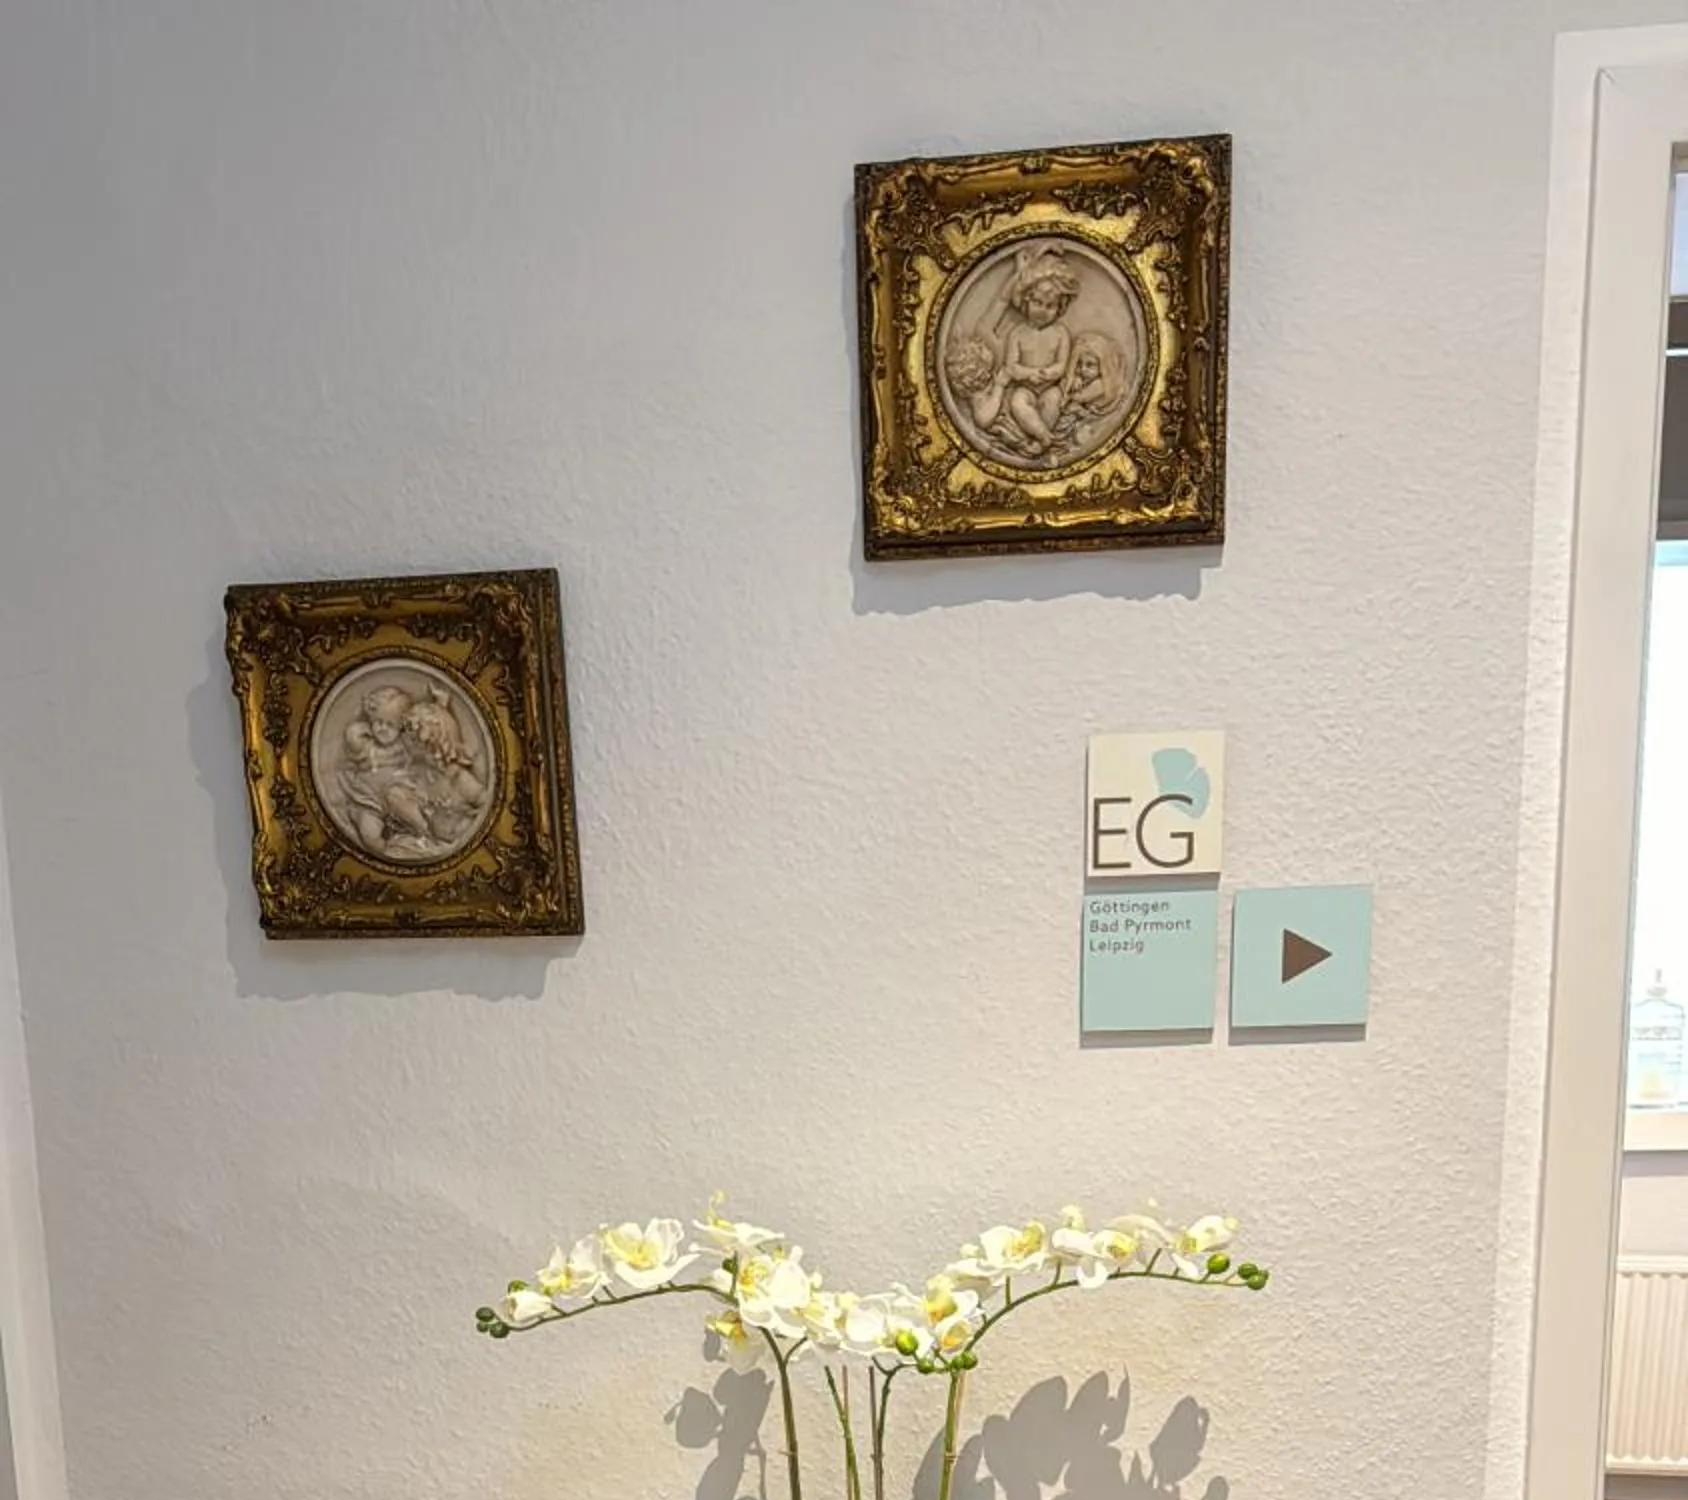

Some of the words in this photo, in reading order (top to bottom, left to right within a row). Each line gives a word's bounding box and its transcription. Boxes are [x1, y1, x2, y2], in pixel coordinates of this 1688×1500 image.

[1092, 793, 1195, 870] EG
[1089, 899, 1170, 916] Göttingen
[1089, 919, 1119, 933] Bad
[1125, 918, 1192, 935] Pyrmont
[1089, 938, 1145, 955] Leipzig
